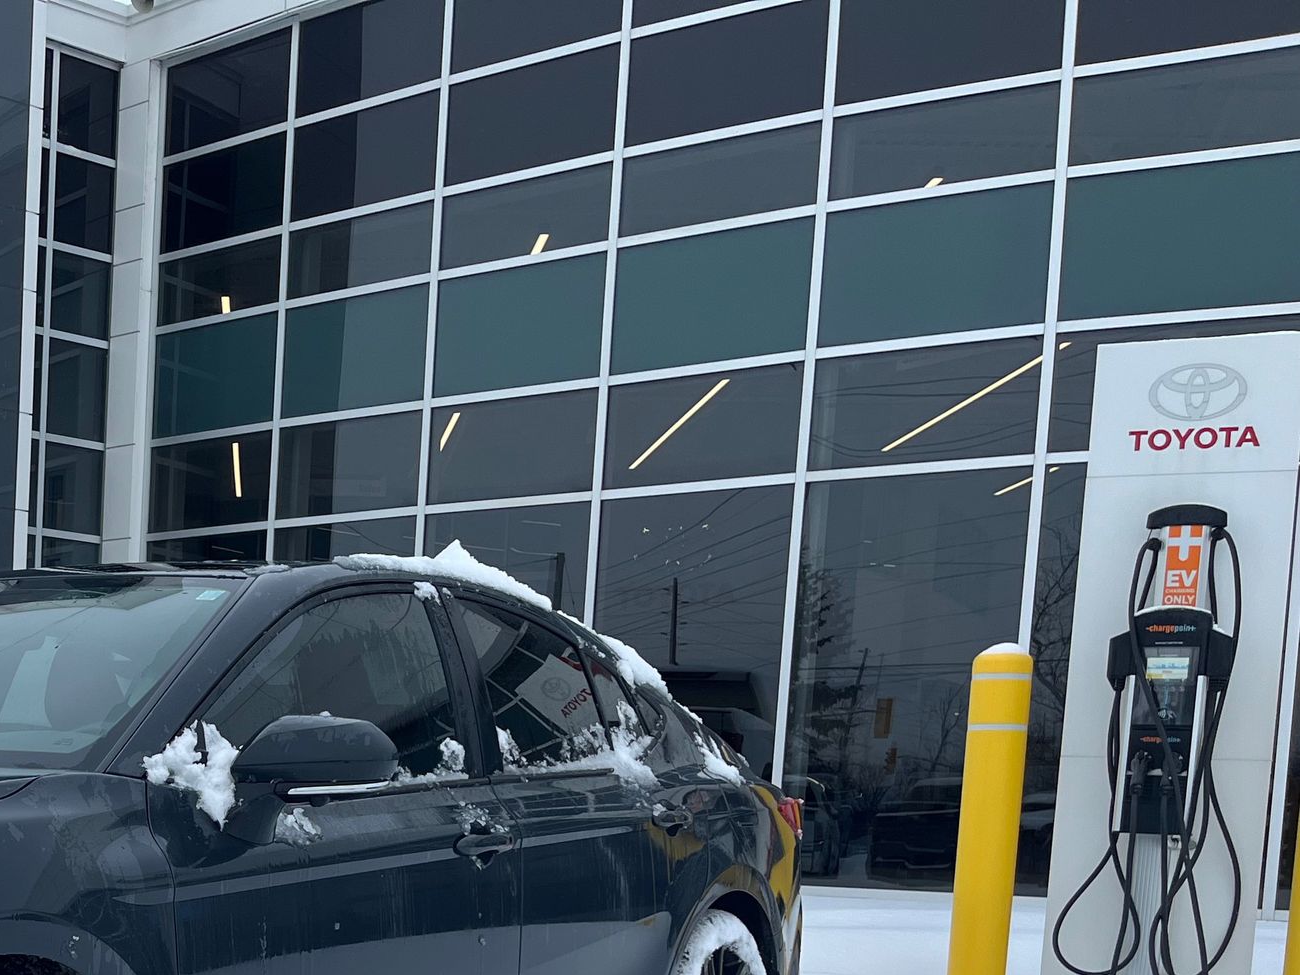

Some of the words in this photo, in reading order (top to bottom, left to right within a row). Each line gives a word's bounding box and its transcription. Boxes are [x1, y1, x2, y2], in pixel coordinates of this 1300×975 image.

[1128, 426, 1261, 451] TOYOTA
[1166, 569, 1198, 587] EV
[1164, 594, 1196, 605] ONLY
